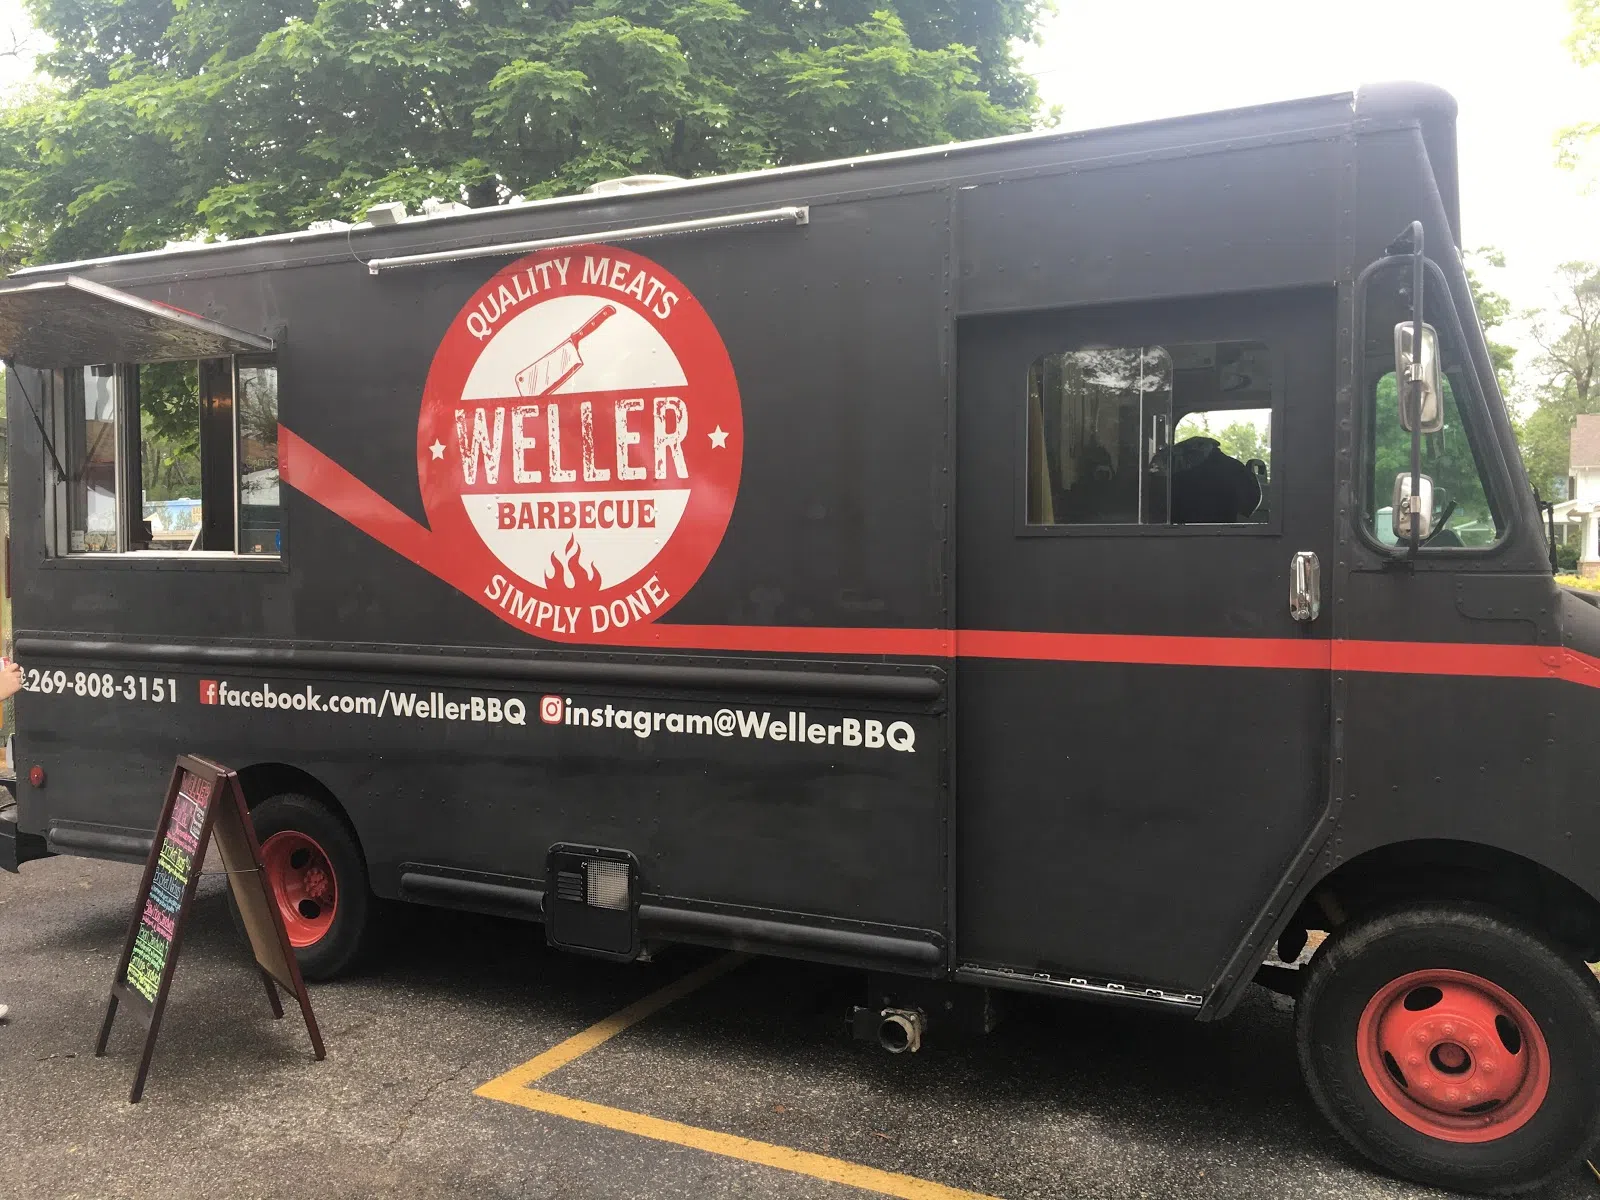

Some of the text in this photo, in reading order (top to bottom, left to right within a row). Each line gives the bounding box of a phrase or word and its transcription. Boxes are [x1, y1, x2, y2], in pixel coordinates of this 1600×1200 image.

[466, 255, 680, 341] QUALITY MEATS
[454, 396, 690, 485] WELLER
[497, 498, 657, 530] BARBECUE
[483, 573, 671, 634] SIMPLY DONE
[28, 668, 178, 704] 269-808-3151
[218, 680, 527, 726] facebook.com/WellerBBQ
[565, 696, 917, 753] instagram@WellerBBQ
